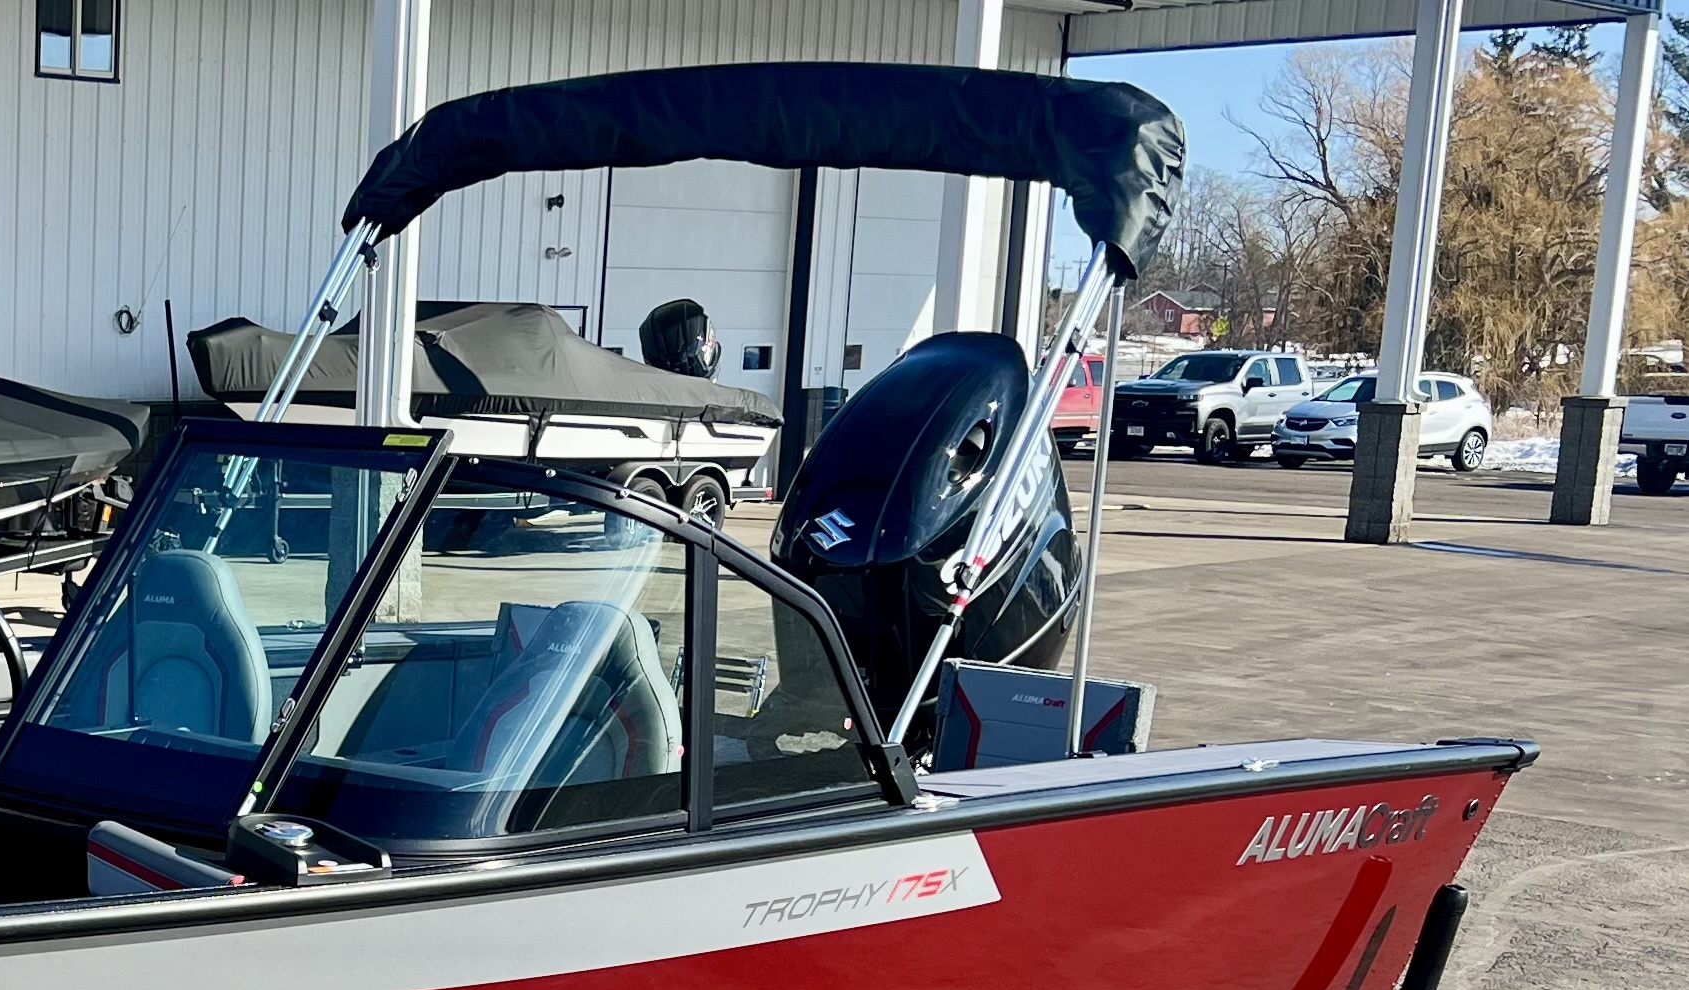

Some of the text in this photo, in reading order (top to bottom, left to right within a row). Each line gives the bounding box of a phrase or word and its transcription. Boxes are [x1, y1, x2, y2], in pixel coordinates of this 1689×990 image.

[1236, 794, 1439, 866] ALUMACraft
[743, 867, 969, 928] TROPHY 175X
